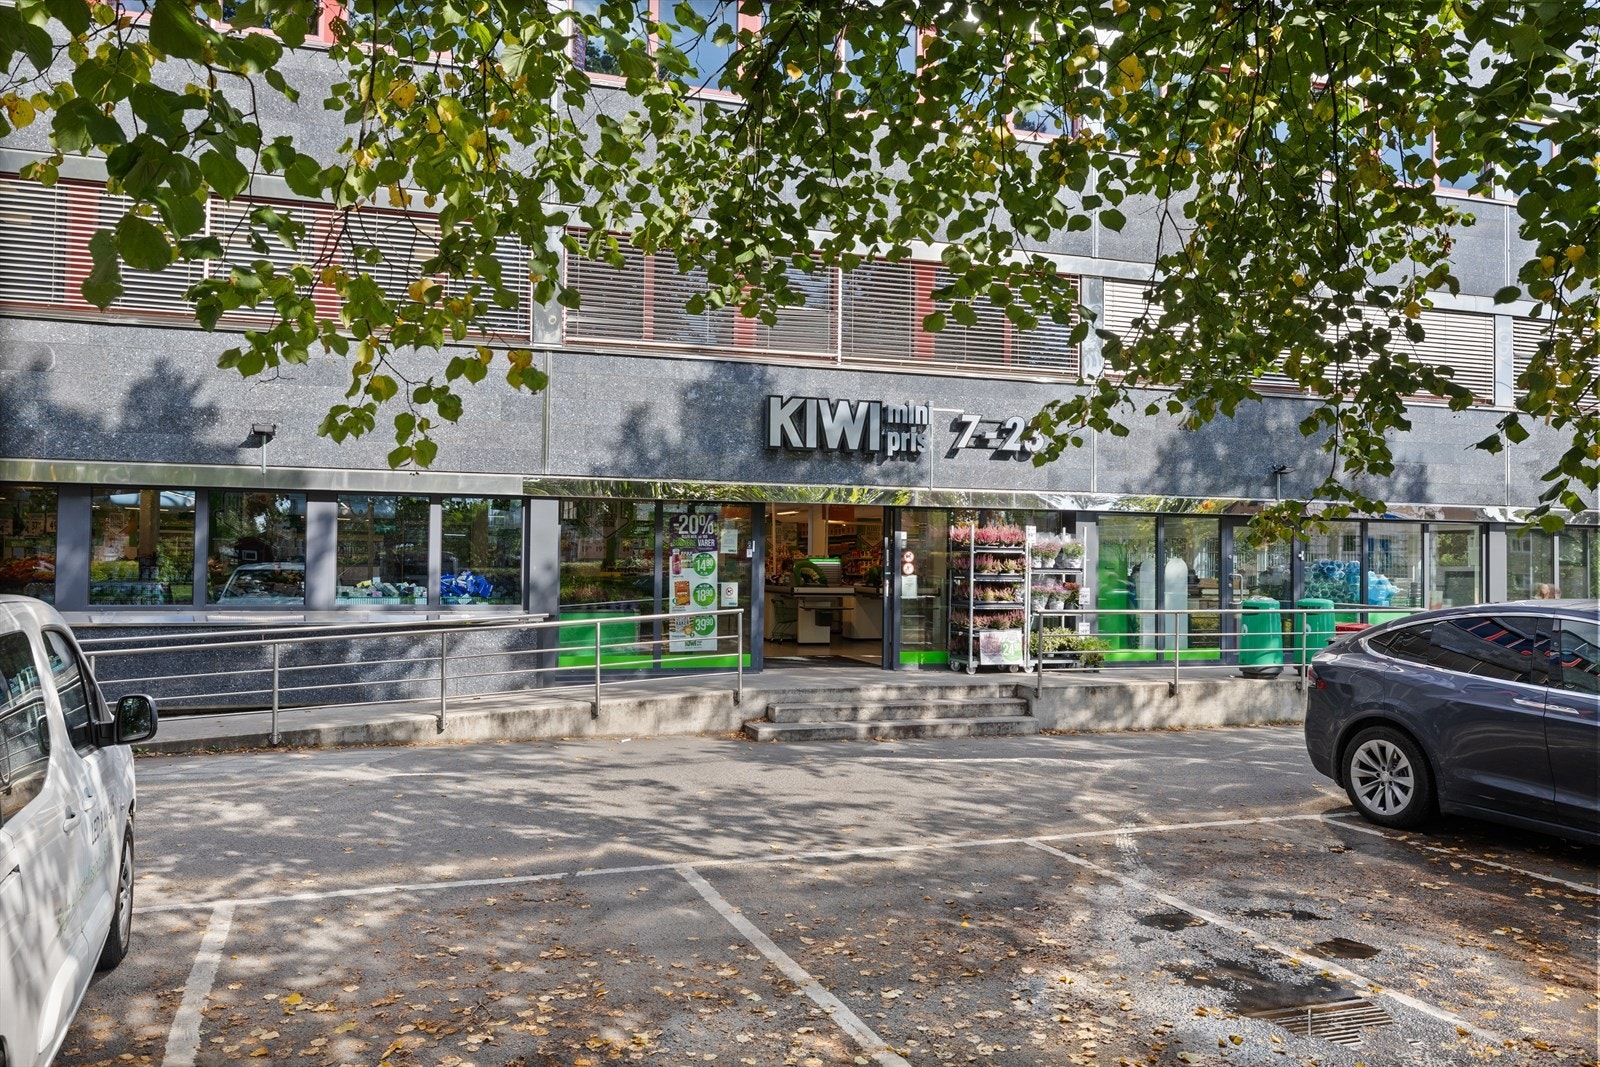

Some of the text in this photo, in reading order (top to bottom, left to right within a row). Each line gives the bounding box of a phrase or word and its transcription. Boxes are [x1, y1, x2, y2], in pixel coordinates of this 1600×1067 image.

[768, 395, 882, 451] KIWI
[888, 400, 934, 424] mini
[888, 426, 926, 457] pris
[673, 514, 714, 535] -20%
[697, 538, 715, 547] VARER
